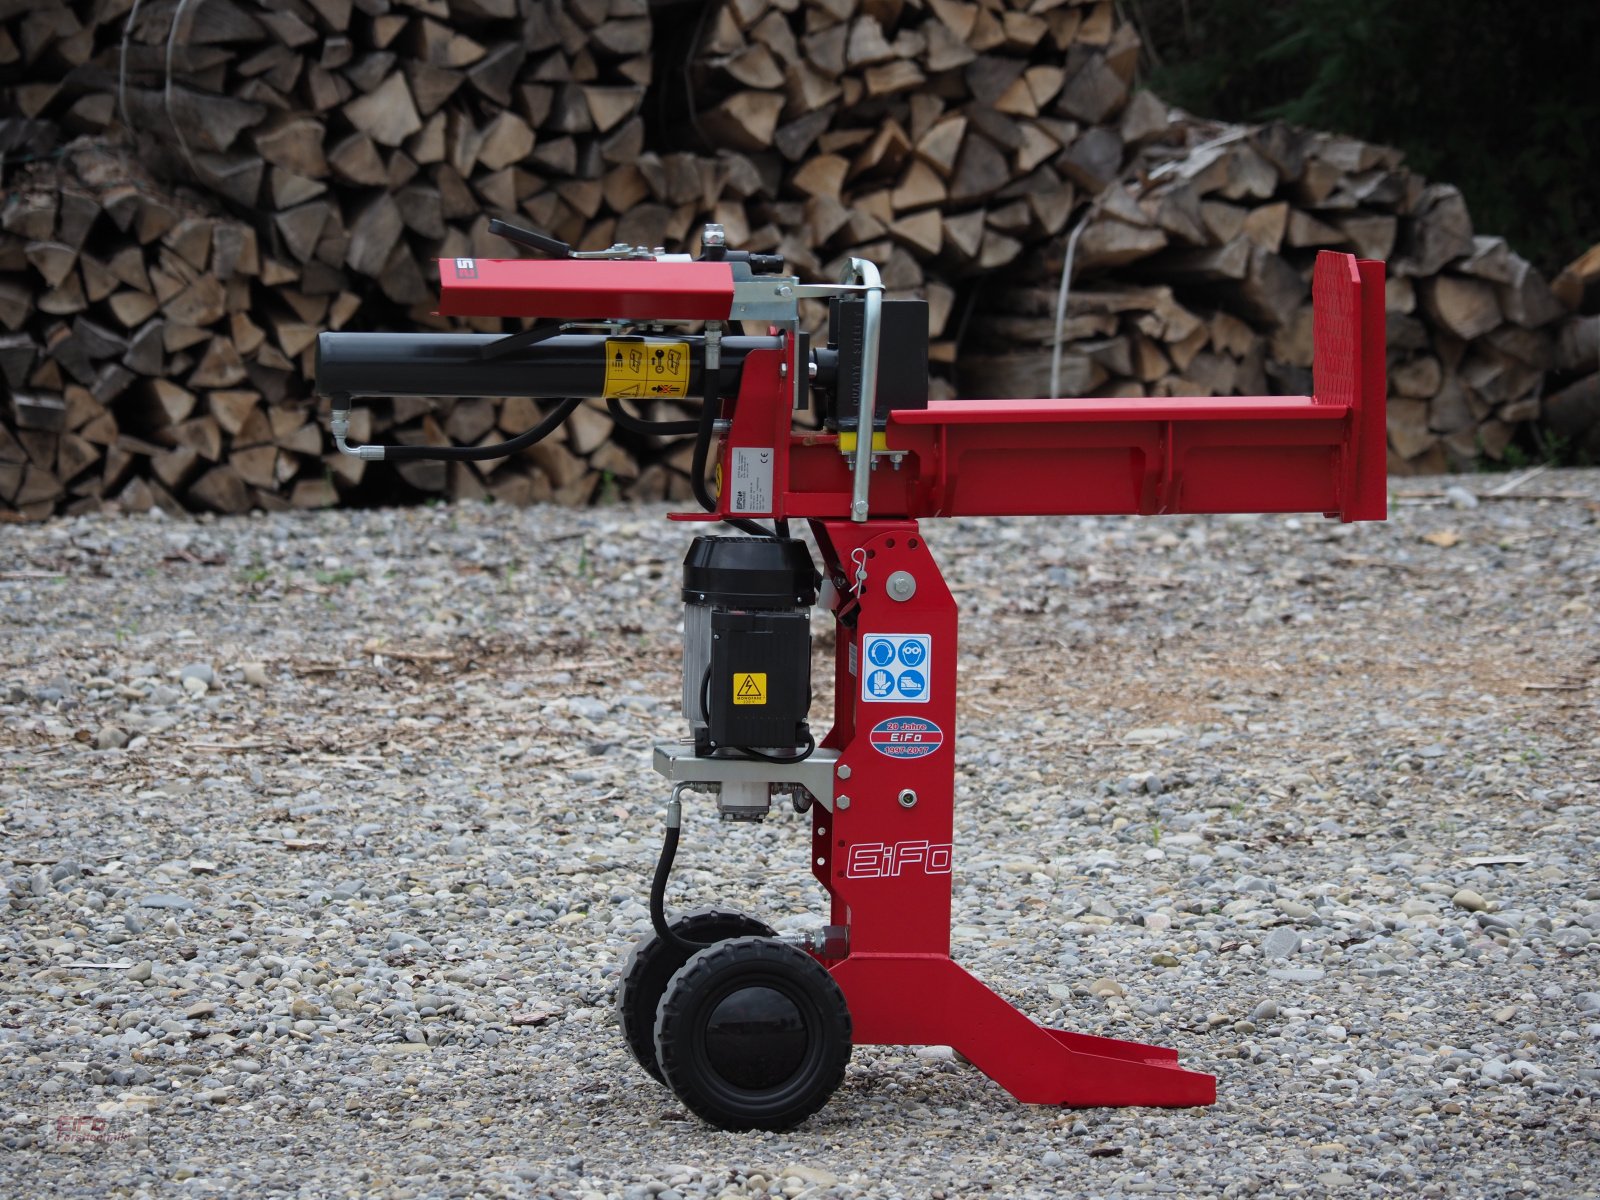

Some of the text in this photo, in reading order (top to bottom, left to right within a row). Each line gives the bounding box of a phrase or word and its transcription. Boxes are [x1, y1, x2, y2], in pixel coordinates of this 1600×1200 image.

[887, 722, 927, 731] 20 Jahre
[890, 733, 922, 742] EiFo
[884, 746, 930, 755] 1997-2017
[846, 840, 953, 879] EiFo
